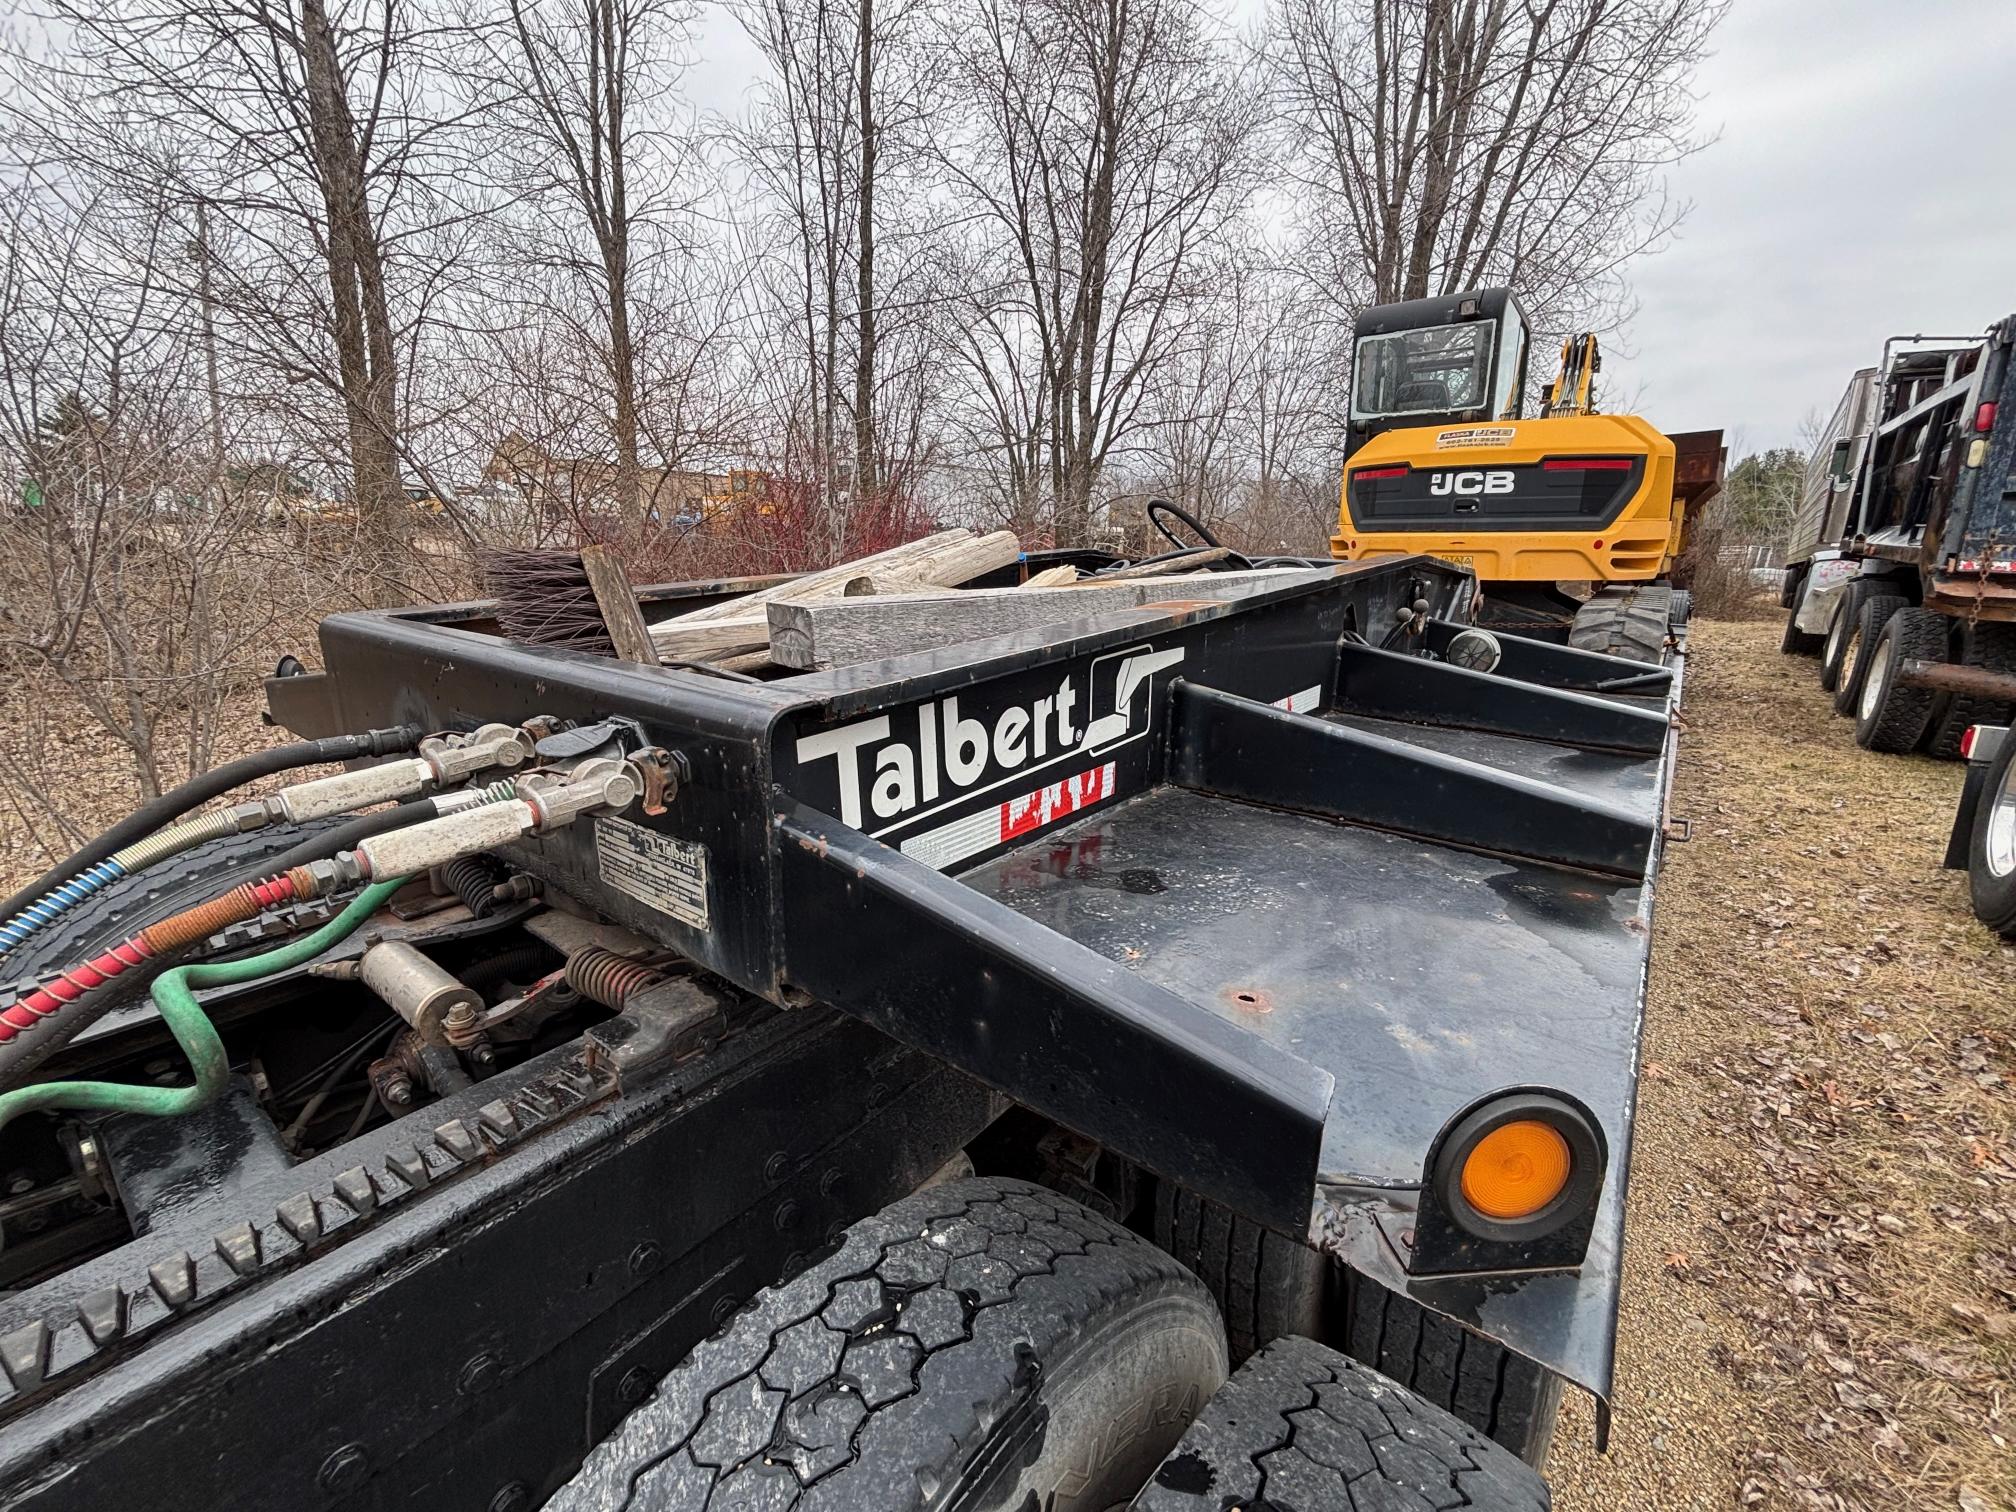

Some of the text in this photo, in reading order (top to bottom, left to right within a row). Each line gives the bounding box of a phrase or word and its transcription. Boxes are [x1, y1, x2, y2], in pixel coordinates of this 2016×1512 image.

[1430, 471, 1515, 496] JCB
[796, 674, 1077, 830] Talbert
[659, 840, 696, 866] Talbert
